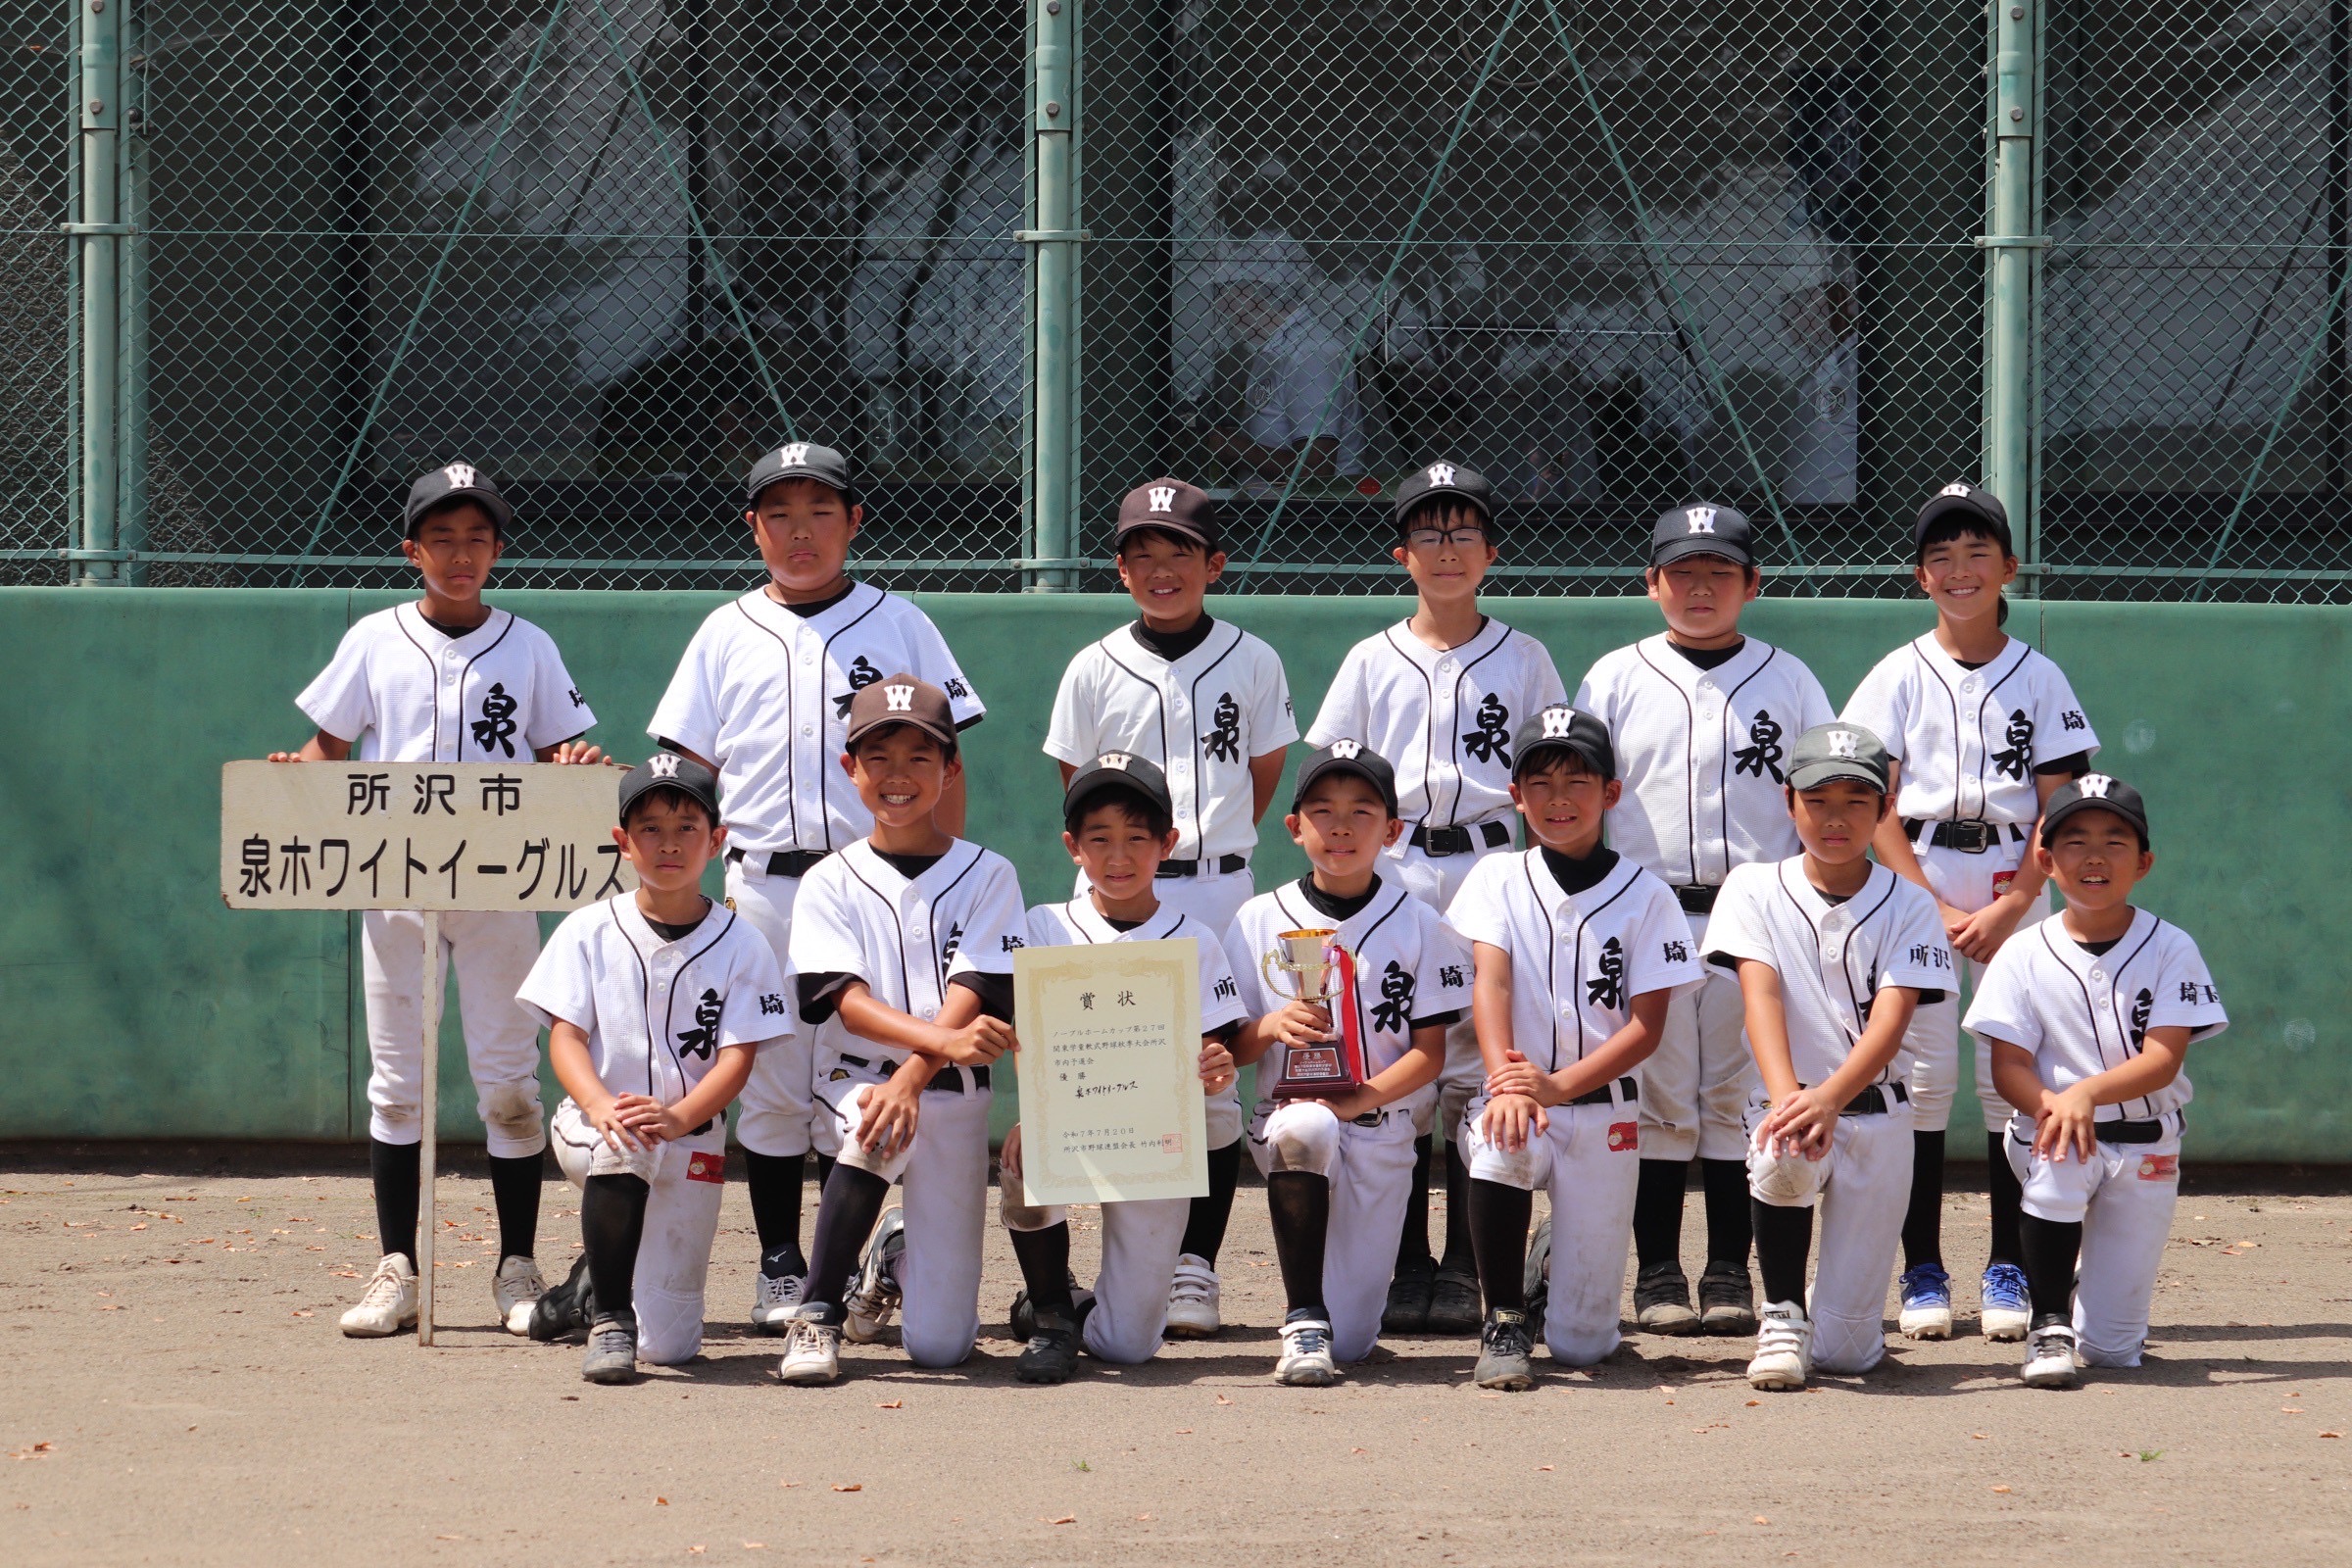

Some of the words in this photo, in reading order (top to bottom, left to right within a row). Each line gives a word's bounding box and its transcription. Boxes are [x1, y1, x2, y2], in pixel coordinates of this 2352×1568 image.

[780, 443, 809, 467] W
[444, 464, 474, 489] W
[1427, 464, 1456, 488] W
[1149, 486, 1177, 513] W
[1940, 482, 1971, 498] W
[1687, 507, 1716, 533] W
[883, 685, 915, 711] W
[944, 675, 975, 701] 埼
[471, 682, 517, 760] 泉
[1200, 692, 1240, 764] 泉
[1461, 692, 1512, 769] 泉
[1542, 708, 1575, 739] W
[1330, 738, 1363, 760] W
[1732, 709, 1785, 784] 泉
[1827, 730, 1861, 759] W
[1991, 709, 2034, 781] 泉
[648, 751, 682, 780] W
[1098, 752, 1133, 771] W
[347, 772, 522, 816] 所沢市
[2079, 774, 2113, 800] W
[239, 832, 626, 901] 泉ホワイトイーグルス
[1663, 941, 1696, 963] 埼
[1909, 943, 1950, 970] 所沢
[760, 994, 791, 1015] 埼
[1079, 990, 1137, 1010] 賞状
[1370, 960, 1415, 1034] 泉
[676, 987, 725, 1061] 泉
